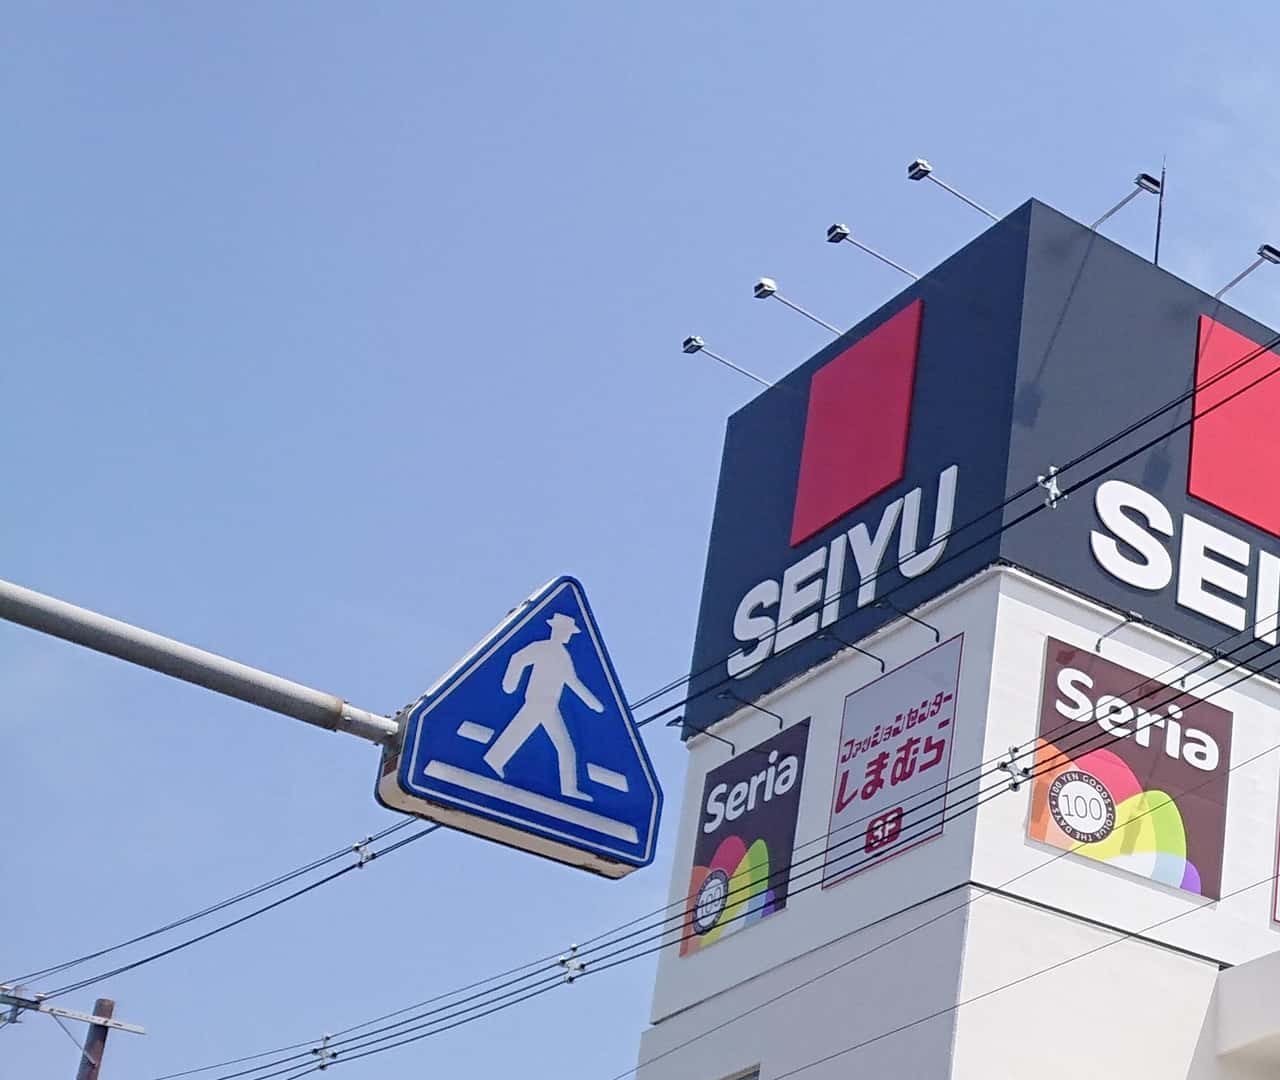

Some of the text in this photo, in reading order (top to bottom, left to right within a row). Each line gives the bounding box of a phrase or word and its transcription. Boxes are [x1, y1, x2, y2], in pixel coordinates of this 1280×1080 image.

[726, 465, 958, 680] SEIYU
[841, 691, 953, 763] ファッションセンター
[1056, 667, 1220, 772] Seria
[703, 750, 799, 833] Seria
[835, 719, 951, 814] しまむら
[1062, 795, 1102, 820] 100
[870, 812, 899, 848] 3F
